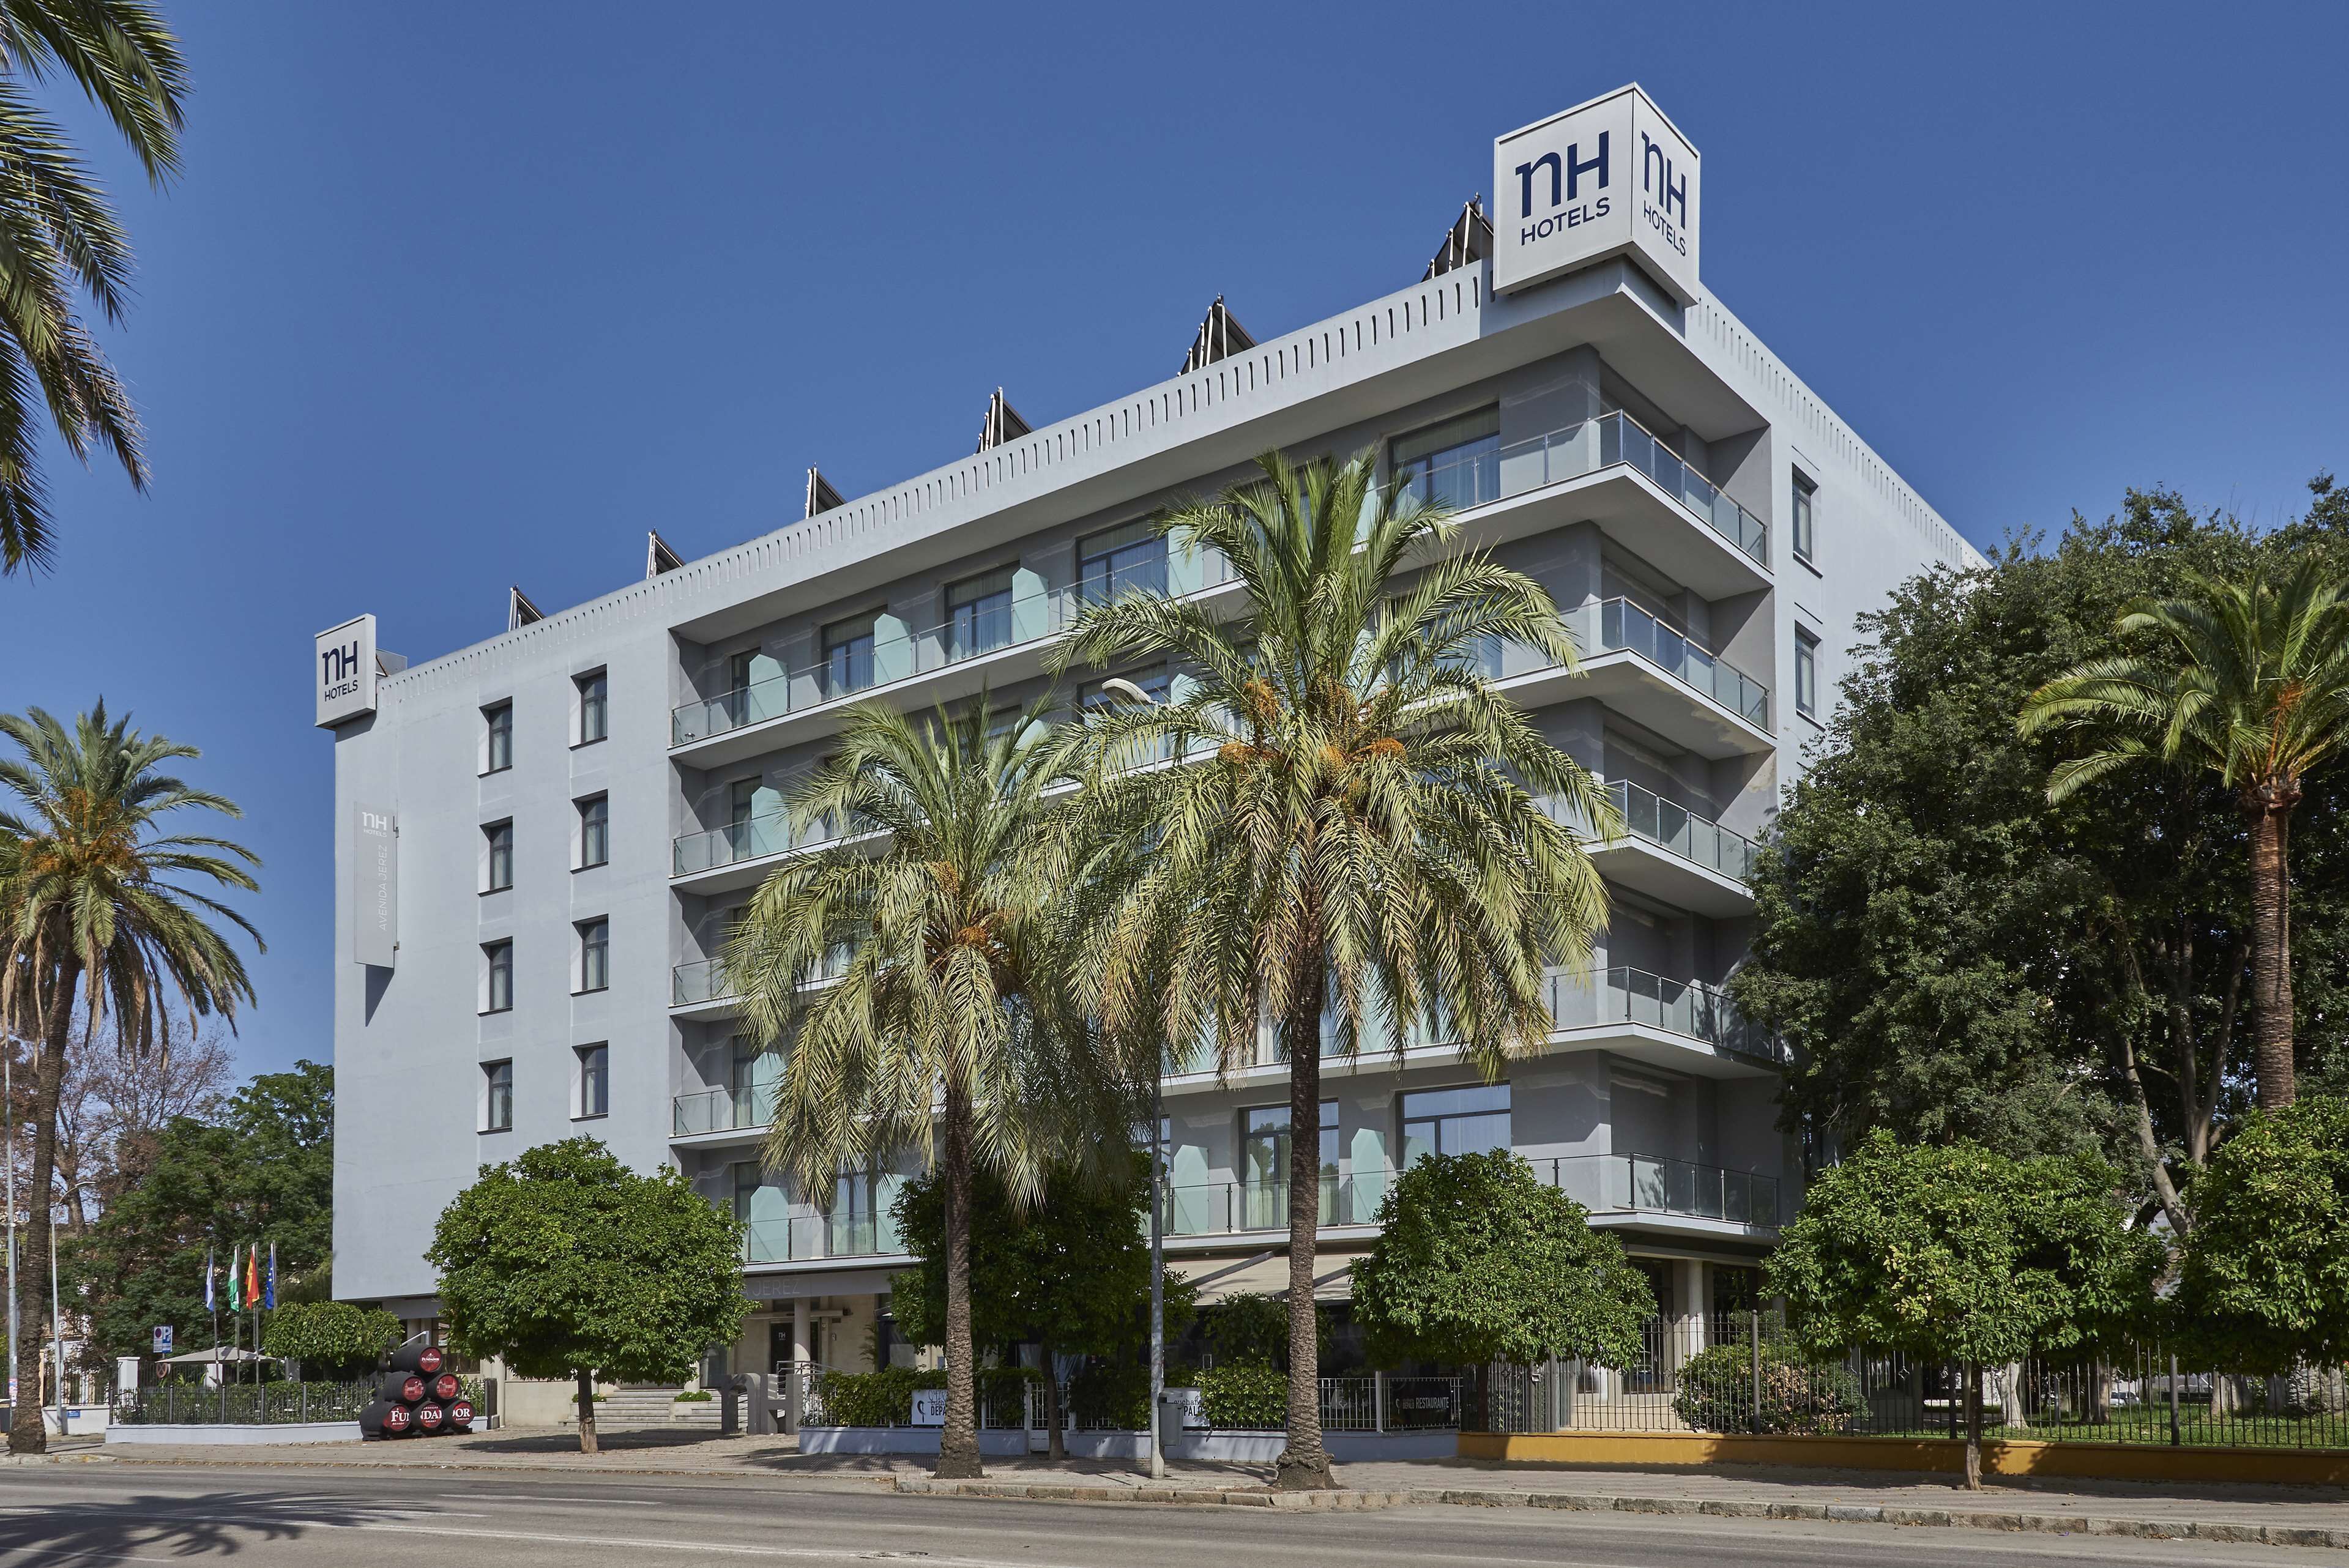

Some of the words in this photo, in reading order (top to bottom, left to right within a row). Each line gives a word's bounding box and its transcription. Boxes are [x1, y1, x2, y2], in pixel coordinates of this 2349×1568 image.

[1521, 196, 1610, 246] HOTELS
[1644, 200, 1686, 257] HOTELS
[324, 680, 358, 702] HOTELS
[363, 828, 387, 837] HOTELS
[378, 844, 387, 881] JEREZ
[379, 883, 387, 931] AVENIDA
[753, 1278, 801, 1296] JEREZ
[1416, 1397, 1449, 1410] RESTAURANTE
